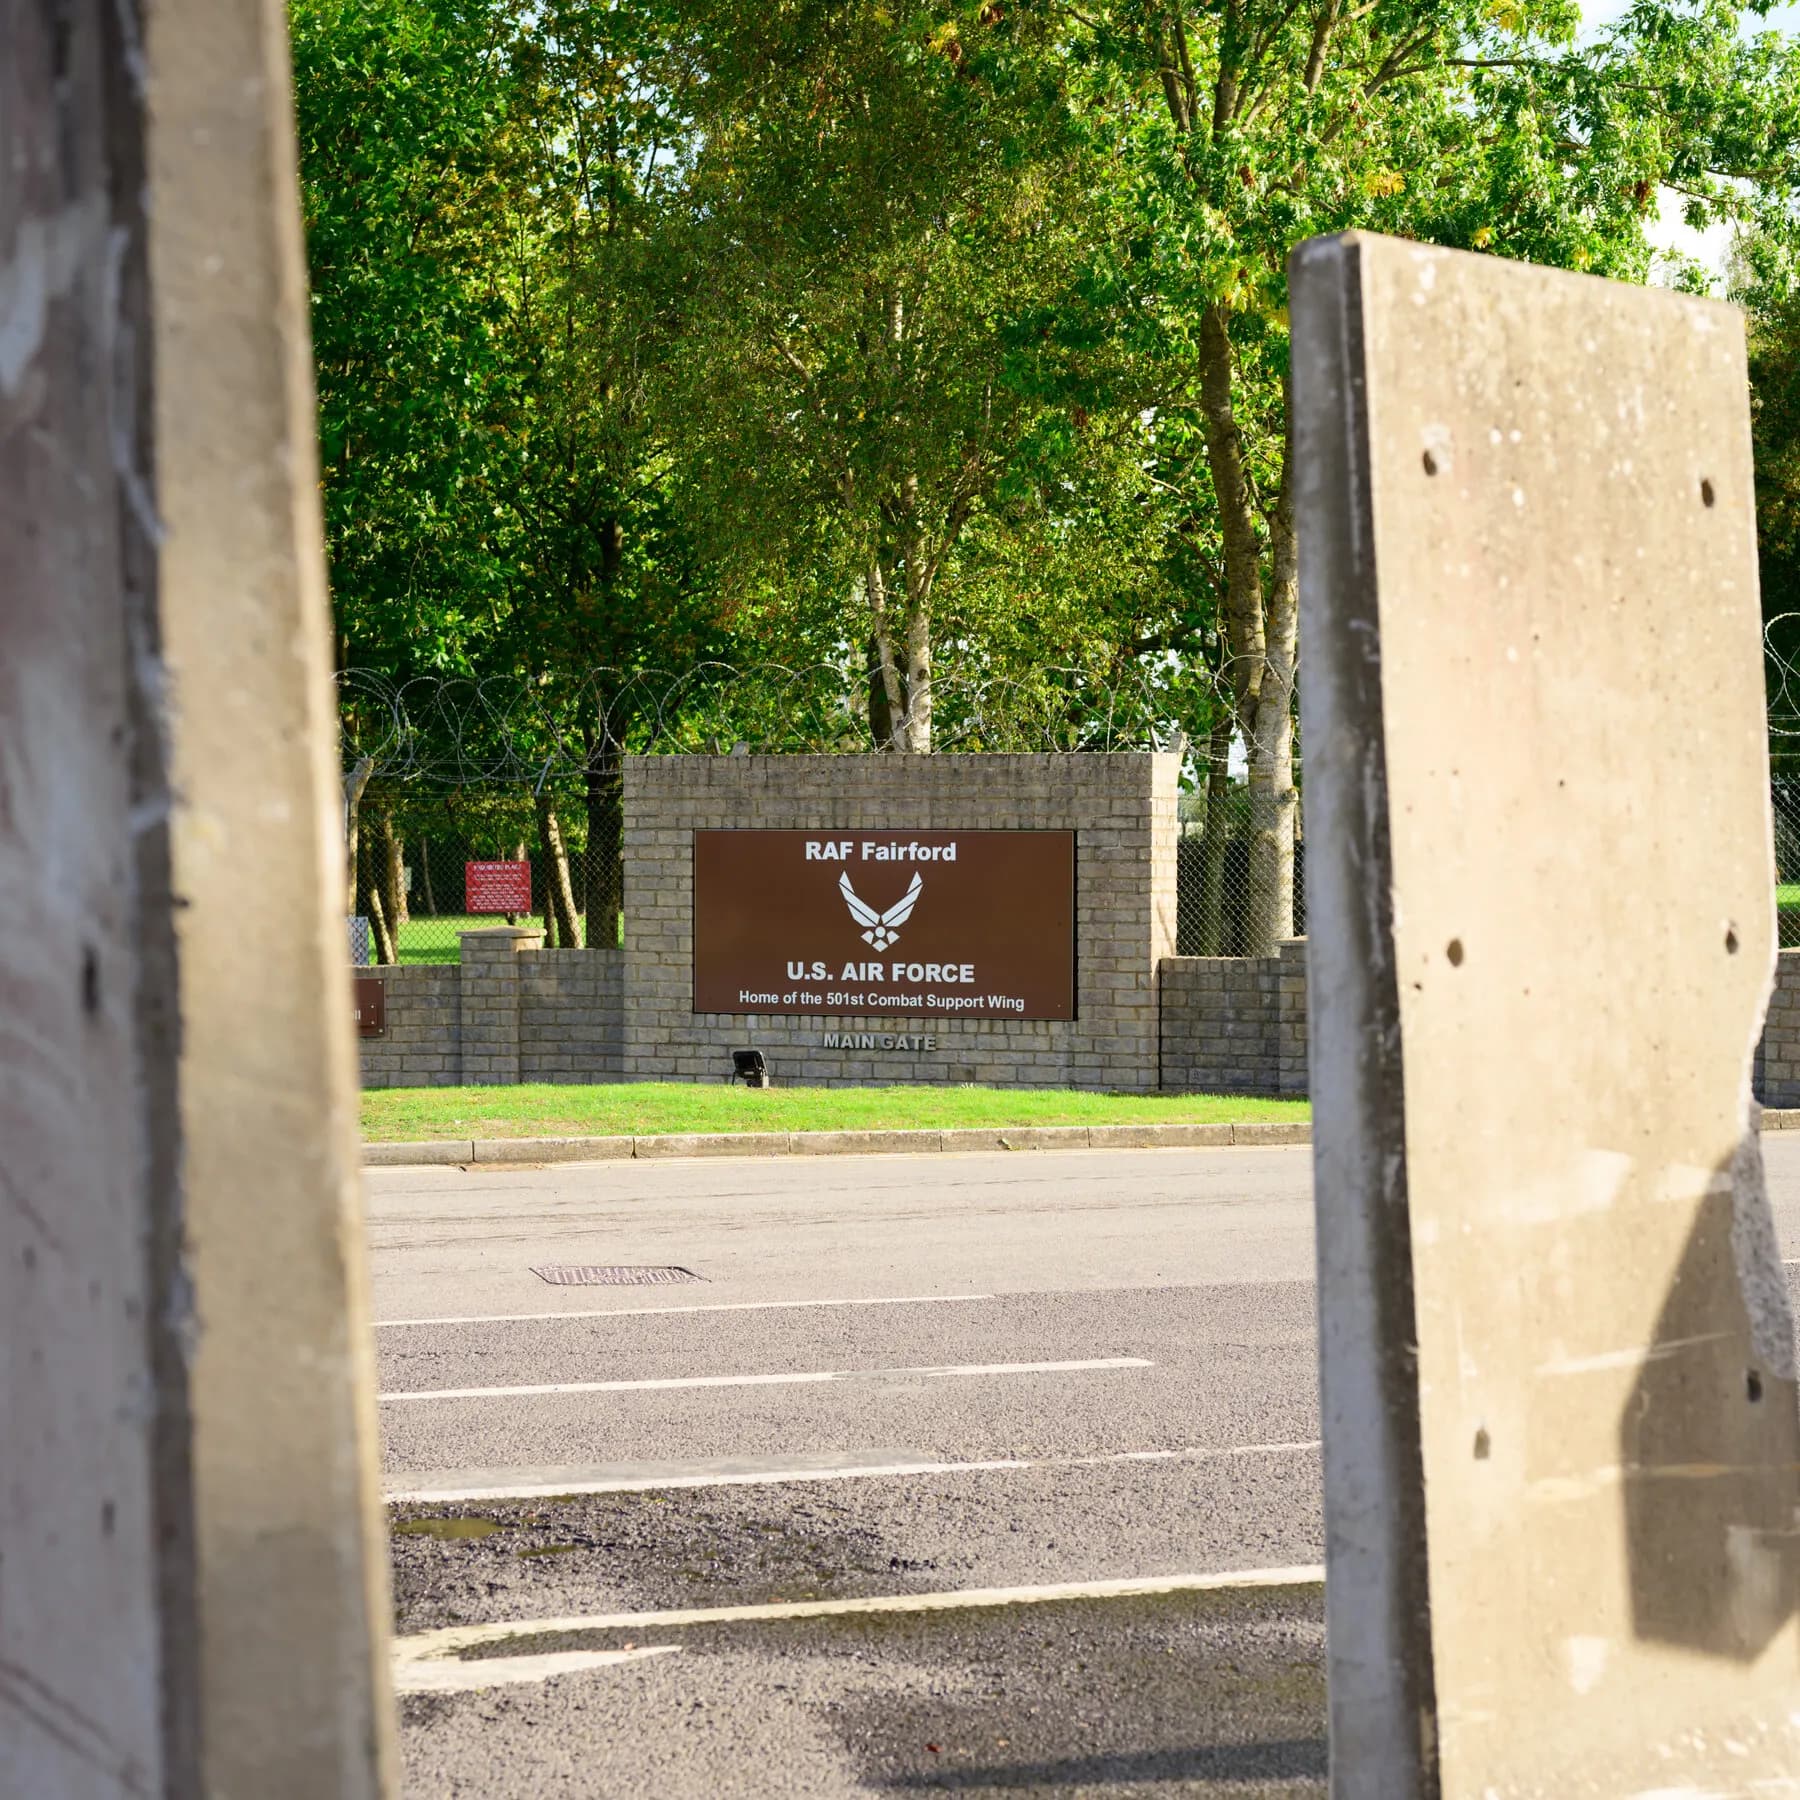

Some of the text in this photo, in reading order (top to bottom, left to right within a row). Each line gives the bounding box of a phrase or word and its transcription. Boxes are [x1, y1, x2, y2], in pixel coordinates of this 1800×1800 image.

[806, 841, 957, 862] RAF Fairford
[787, 962, 975, 983] U.S. AIR FORCE
[739, 990, 1025, 1012] Home of the 501st Combat Support Wing
[823, 1033, 937, 1051] MAIN GATE
